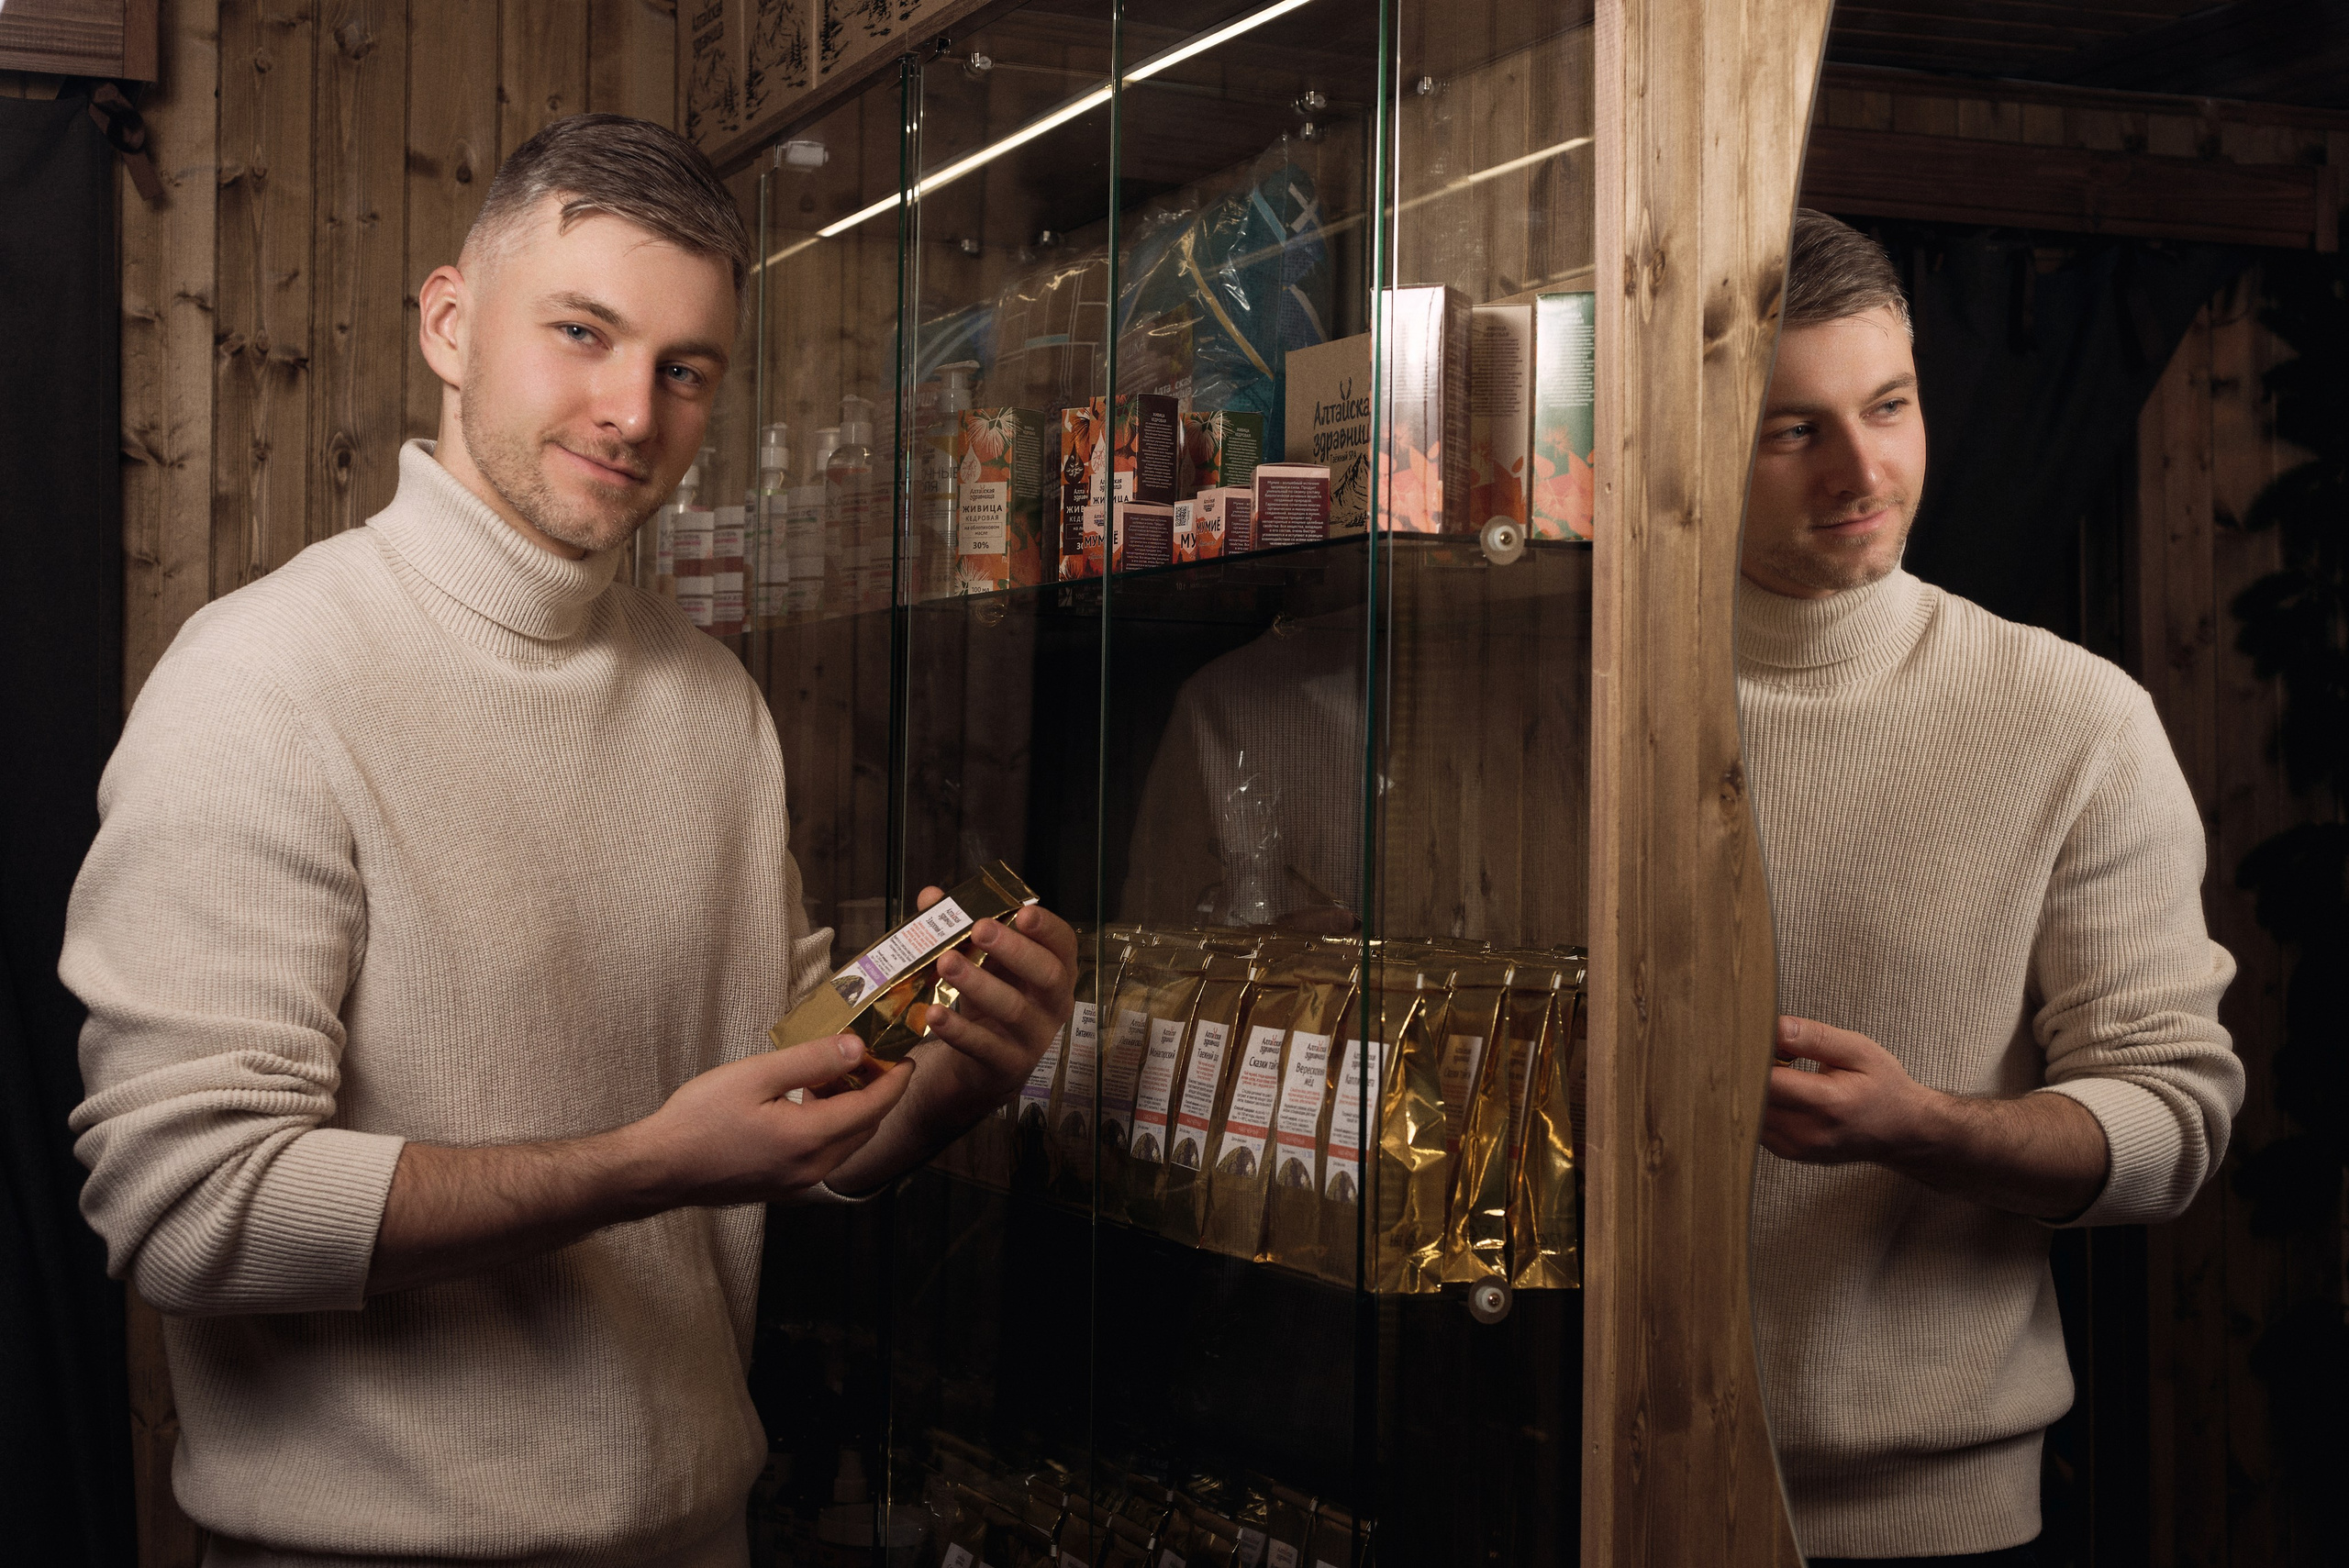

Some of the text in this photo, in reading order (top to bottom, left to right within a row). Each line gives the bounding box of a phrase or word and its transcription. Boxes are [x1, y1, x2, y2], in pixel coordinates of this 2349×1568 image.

[1313, 385, 1370, 430] Алтайска
[1313, 423, 1370, 463] здравниц
[1093, 495, 1129, 504] ЖИИЦА
[962, 505, 1002, 513] ЖИВИЦА
[1066, 506, 1084, 514] ЖИВ
[1197, 517, 1221, 532] МУМИЁ
[1085, 531, 1118, 548] МУМЁ
[1249, 1056, 1267, 1068] Сказки
